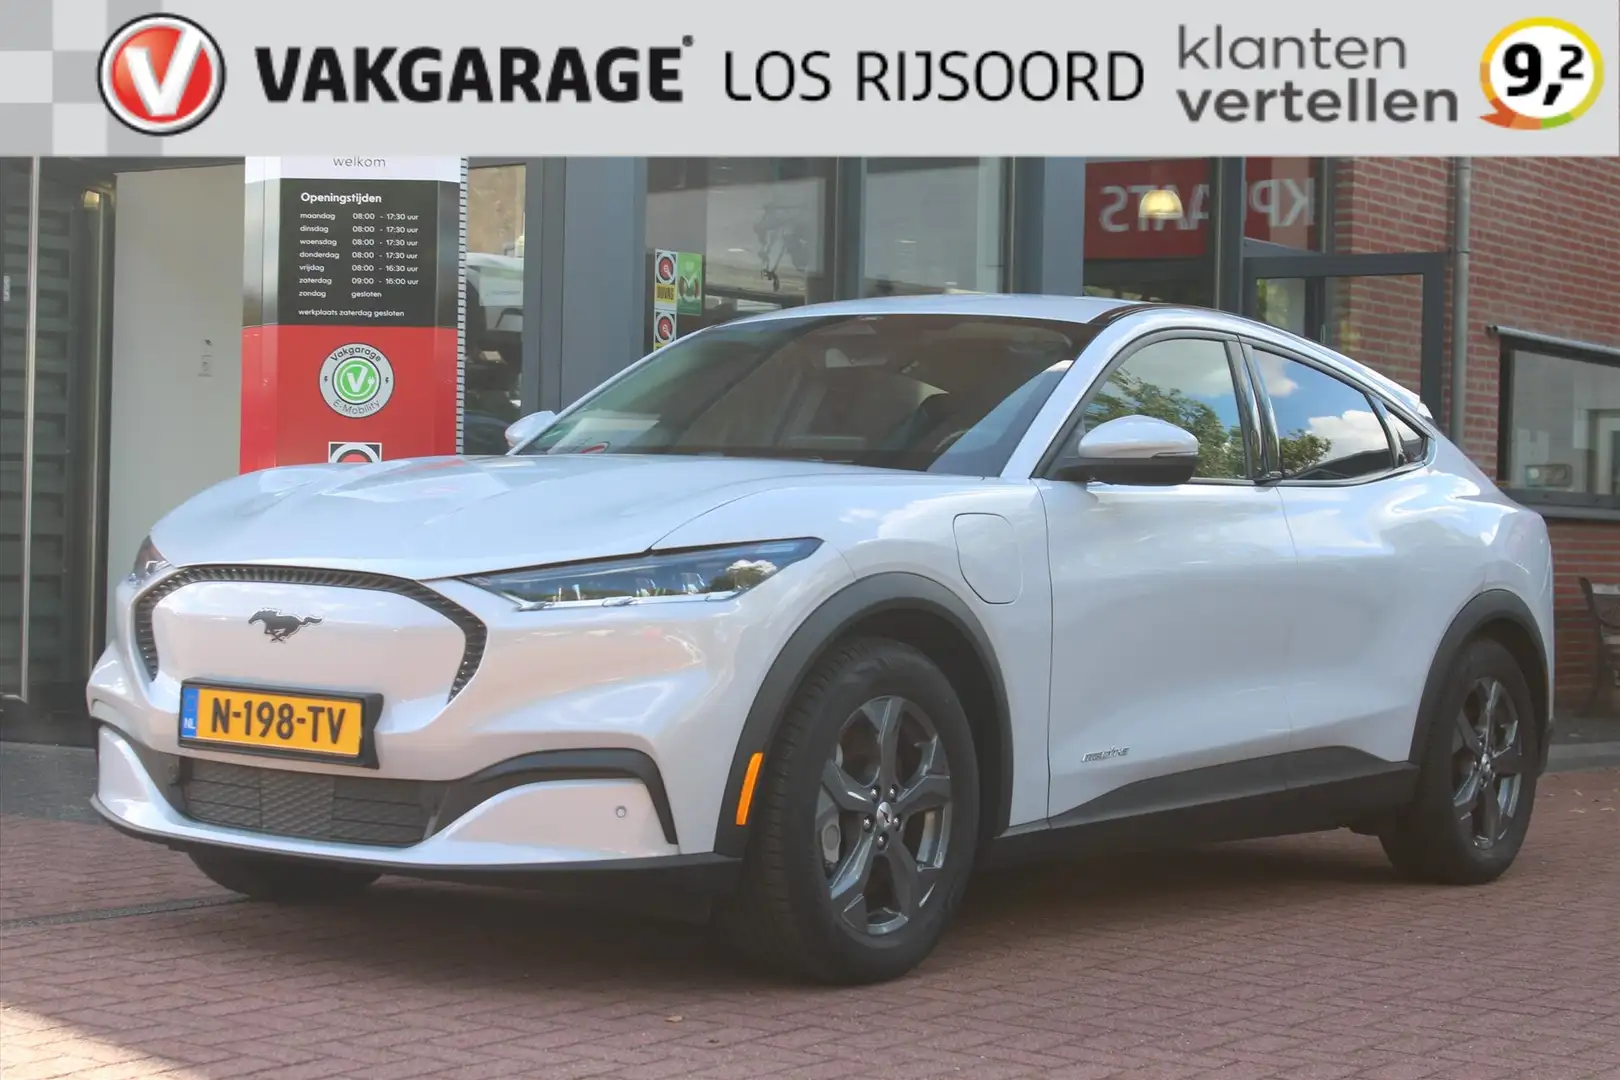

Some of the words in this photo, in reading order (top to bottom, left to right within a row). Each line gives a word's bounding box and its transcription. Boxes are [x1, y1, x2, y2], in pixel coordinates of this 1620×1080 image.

[333, 156, 386, 168] welkom
[301, 192, 382, 205] Openingstijden
[299, 212, 336, 221] maandag
[352, 212, 376, 220] 08:00
[299, 224, 329, 233] dinsdag
[352, 225, 375, 233] 08:00
[299, 238, 338, 246] woensdag
[352, 238, 375, 246] 08:00
[299, 251, 340, 260] donderdag
[351, 251, 375, 259] 08:00
[299, 264, 325, 273] vrijdag
[351, 264, 374, 272] 08:00
[298, 277, 333, 286] zaterdag
[351, 277, 375, 285] 09:00
[298, 290, 327, 299] zondag
[351, 290, 382, 299] gesloten
[298, 309, 338, 318] werkplaats
[338, 310, 373, 318] zaterdag
[373, 310, 405, 318] gesloten
[330, 346, 382, 363] Vakgarage
[333, 398, 380, 416] E-Mobility
[211, 697, 346, 745] N-198-TV
